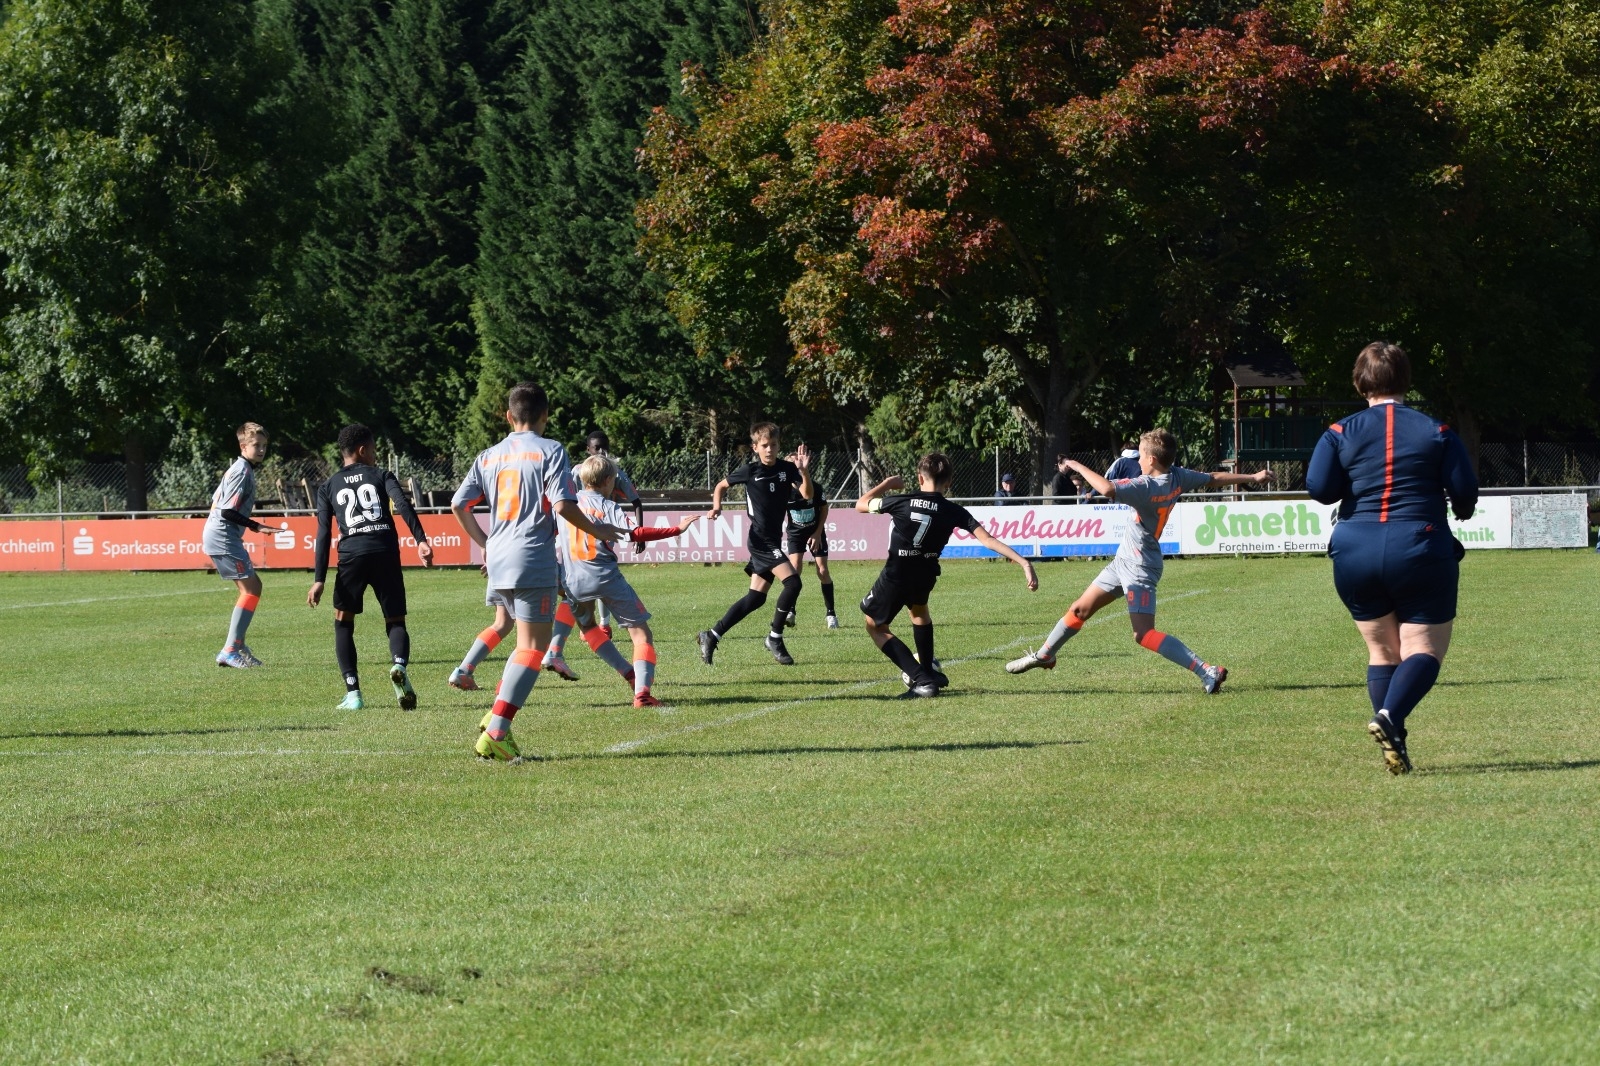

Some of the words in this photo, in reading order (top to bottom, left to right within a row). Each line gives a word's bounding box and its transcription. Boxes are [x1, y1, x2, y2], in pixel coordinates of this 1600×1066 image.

[343, 473, 364, 484] VOGT
[769, 482, 775, 492] 8
[497, 469, 520, 520] 8
[336, 483, 383, 528] 29
[909, 498, 938, 512] TREGLIA
[909, 511, 932, 548] 7
[1195, 504, 1321, 546] Kmeth
[102, 540, 175, 558] Sparkasse
[829, 539, 846, 552] 82
[850, 539, 867, 552] 30
[1219, 542, 1275, 551] Forchheim
[1284, 541, 1329, 550] Eberma
[619, 550, 735, 562] TRANSPORTE
